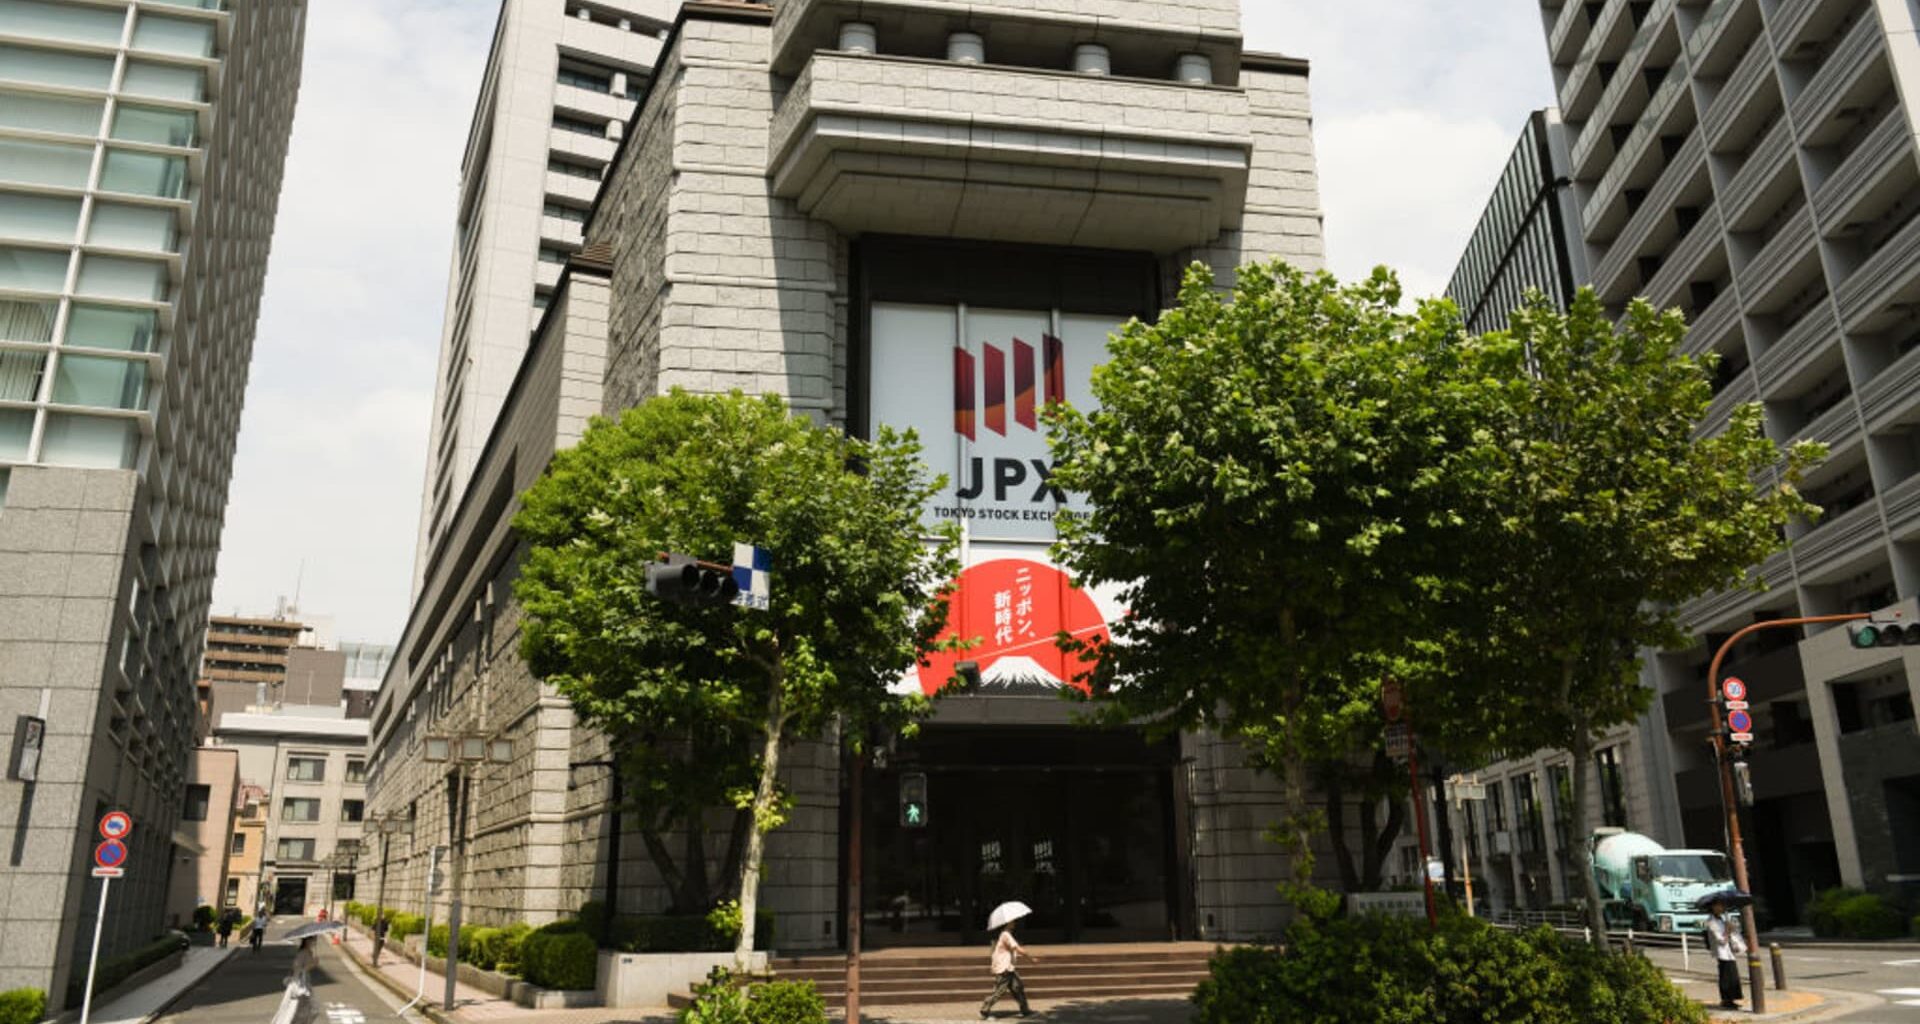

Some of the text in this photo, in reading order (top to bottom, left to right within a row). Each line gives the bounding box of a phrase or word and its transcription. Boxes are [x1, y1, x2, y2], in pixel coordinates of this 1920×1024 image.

[956, 457, 1067, 503] JPX
[934, 507, 975, 519] TOKYO
[979, 508, 1019, 520] STOCK
[995, 590, 1013, 646] 新時代
[1015, 567, 1035, 638] ニッポン、
